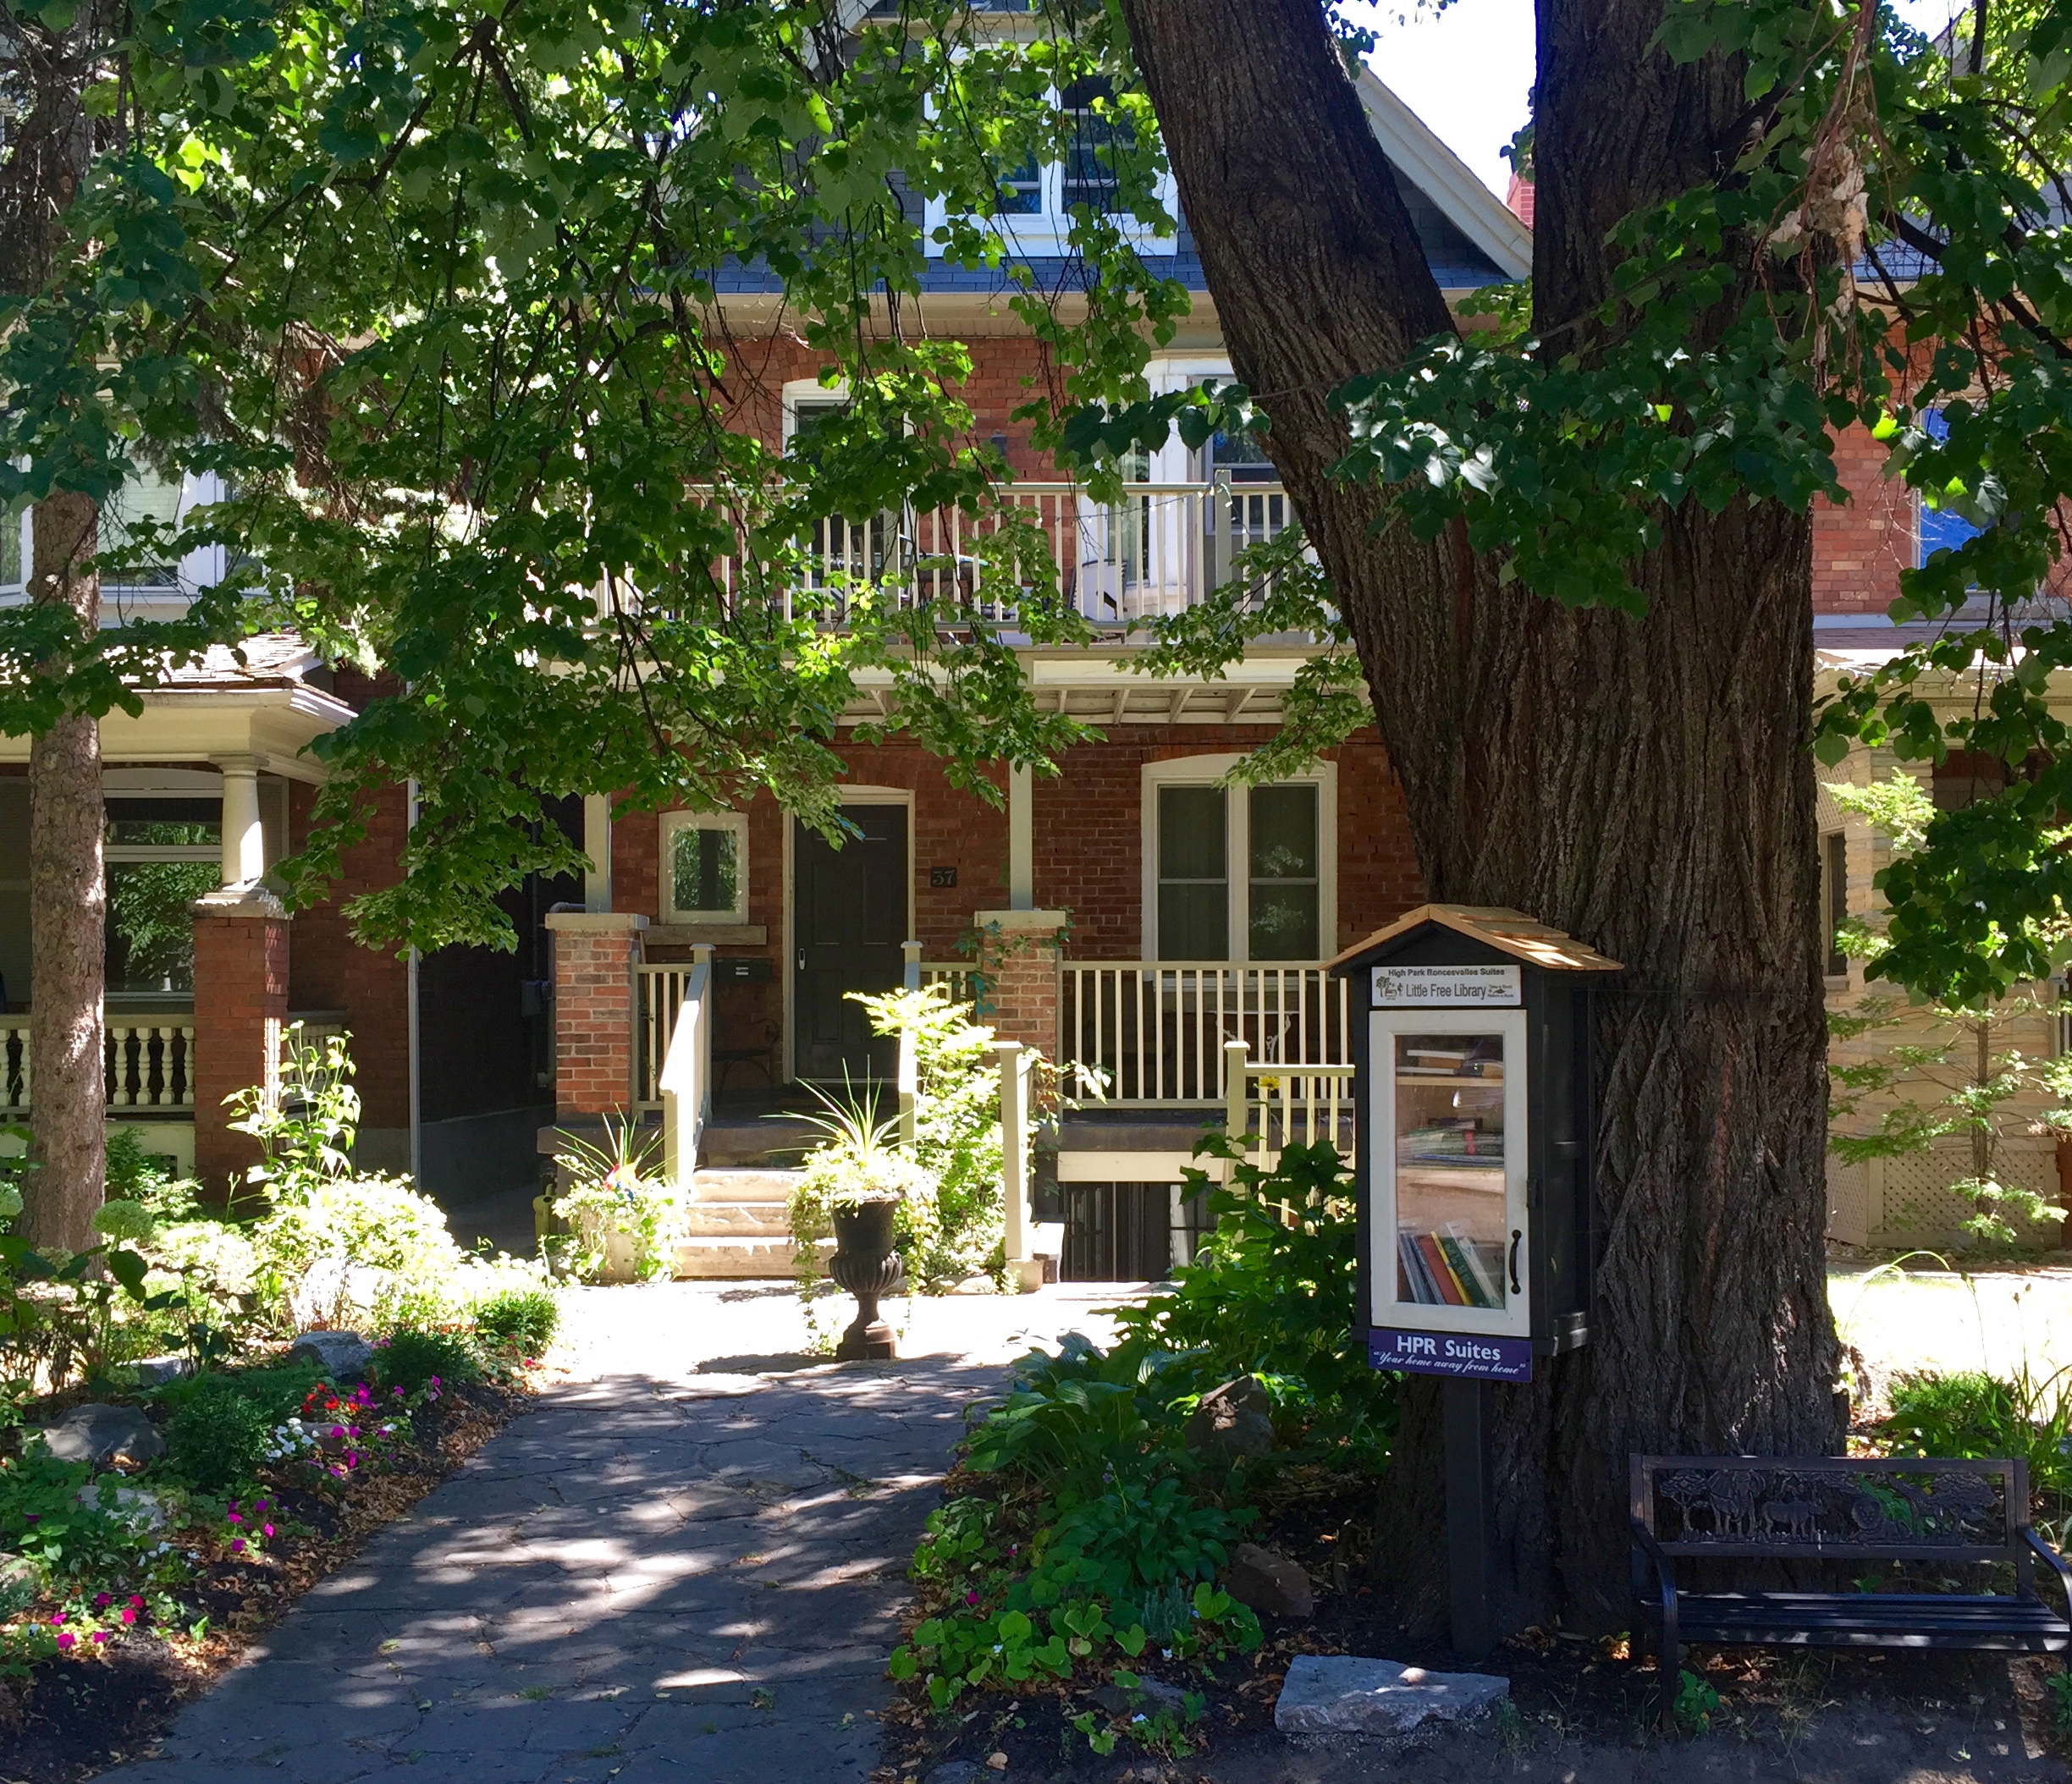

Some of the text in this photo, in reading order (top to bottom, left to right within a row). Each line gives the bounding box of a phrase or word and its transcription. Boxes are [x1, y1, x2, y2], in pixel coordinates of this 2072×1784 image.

[933, 869, 956, 885] 37
[1388, 969, 1406, 978] High
[1406, 983, 1486, 1000] Little Free Library
[1397, 1335, 1502, 1361] HPR Suites
[1405, 1355, 1432, 1367] home
[1434, 1361, 1463, 1373] away
[1463, 1359, 1490, 1374] from
